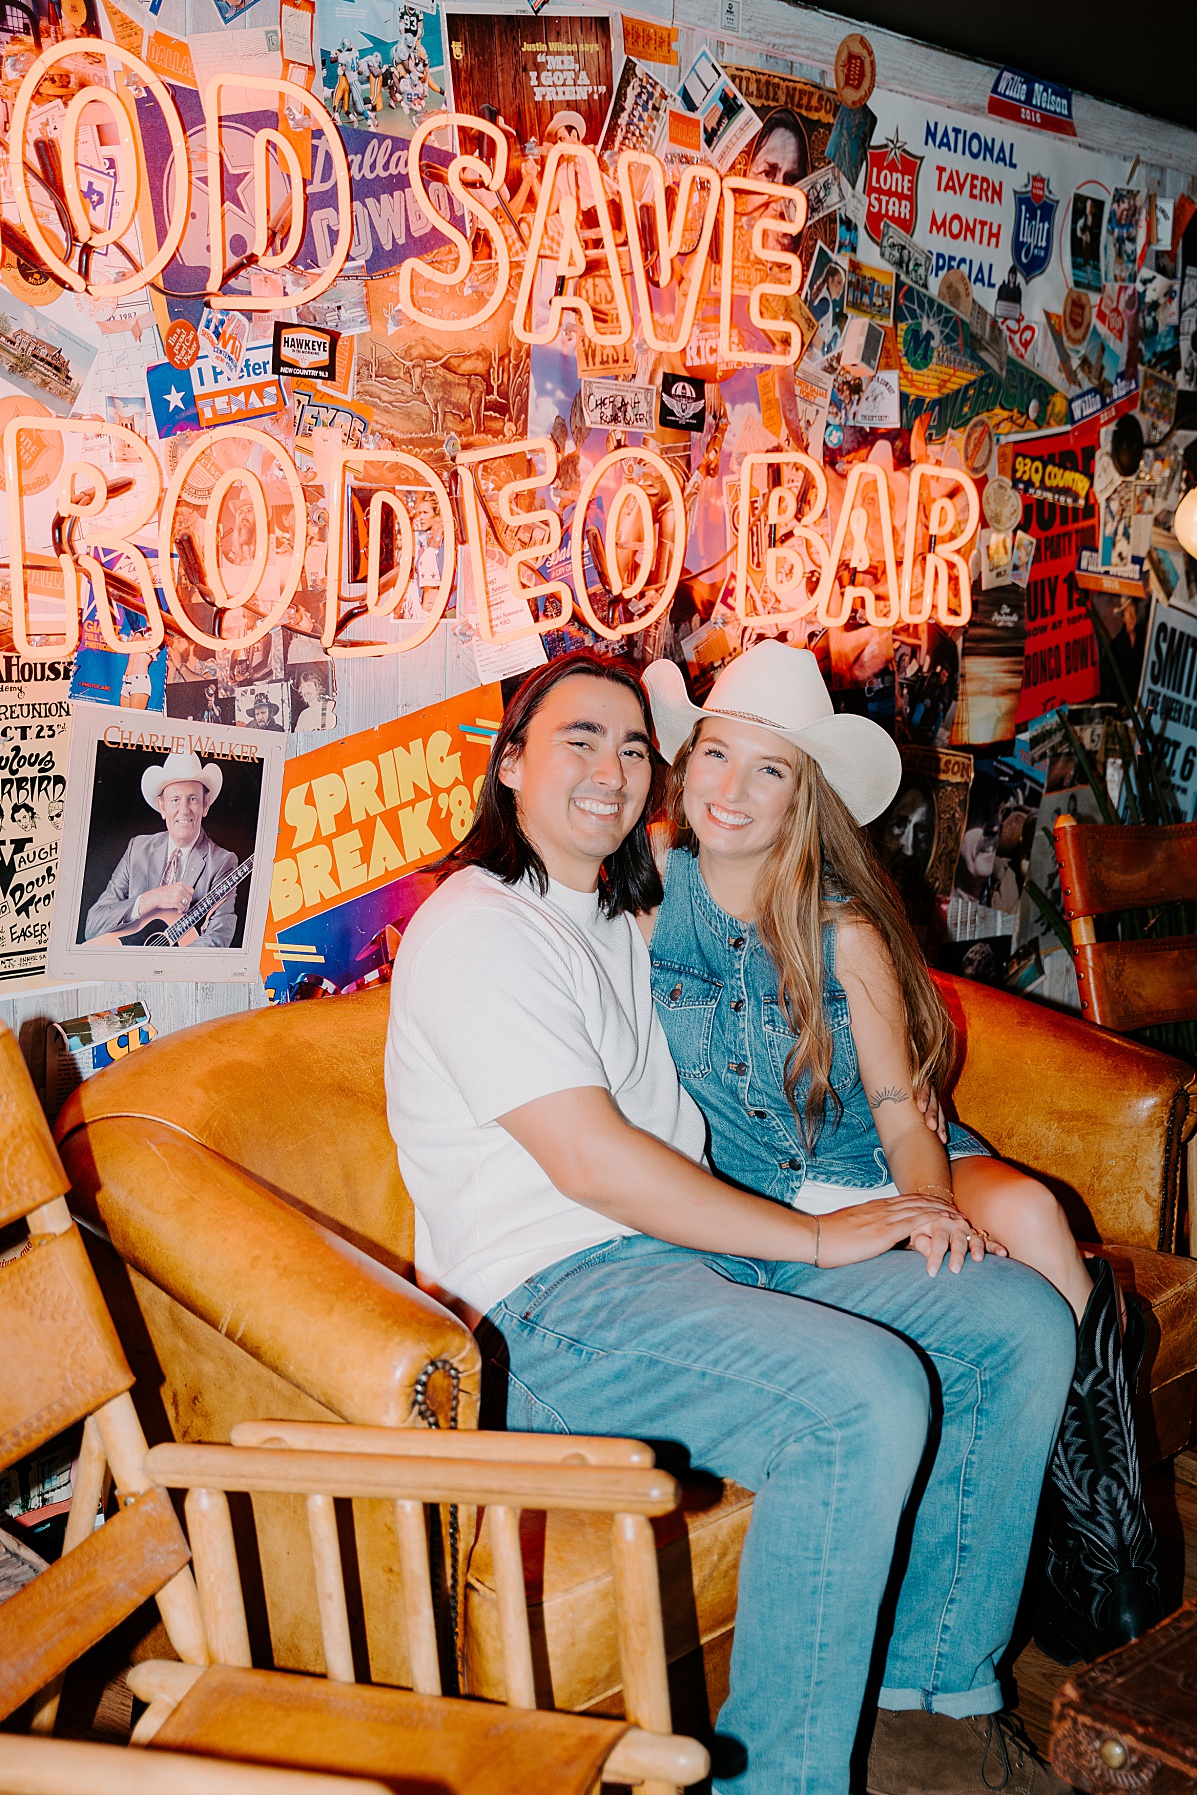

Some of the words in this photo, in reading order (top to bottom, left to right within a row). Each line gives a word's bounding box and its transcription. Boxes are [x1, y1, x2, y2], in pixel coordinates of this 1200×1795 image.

[521, 41, 548, 52] Justin
[548, 41, 578, 52] Wilson
[578, 42, 600, 53] says
[529, 70, 538, 86] I
[540, 70, 576, 86] GOT
[577, 70, 590, 86] A
[997, 70, 1027, 101] Willie
[1032, 82, 1069, 116] Nelson
[924, 119, 1018, 169] NATIONAL
[306, 135, 410, 195] Dalla
[872, 167, 913, 195] LONE
[935, 165, 1003, 206] TAVERN
[869, 192, 911, 219] STAR
[400, 112, 808, 368] SAVE
[928, 208, 1001, 249] MONTH
[1019, 203, 1050, 264] light
[173, 329, 187, 355] proud
[182, 341, 198, 367] Picker
[282, 336, 329, 353] HAWKEYE
[280, 366, 293, 374] NEW
[293, 367, 319, 378] COUNTRY
[197, 385, 279, 419] TEXAS
[1070, 394, 1102, 422] Willie
[21, 472, 51, 495] quality
[1015, 455, 1043, 487] 93Q
[1044, 463, 1091, 499] COUNTRY
[3, 414, 687, 660] RODEO
[735, 450, 981, 629] BAR
[1026, 571, 1060, 623] ULY
[1023, 642, 1062, 691] RONCO
[103, 725, 185, 755] CHARLIE
[187, 734, 260, 764] WALKER
[283, 730, 465, 850] SPRING
[268, 804, 442, 922] BREAK
